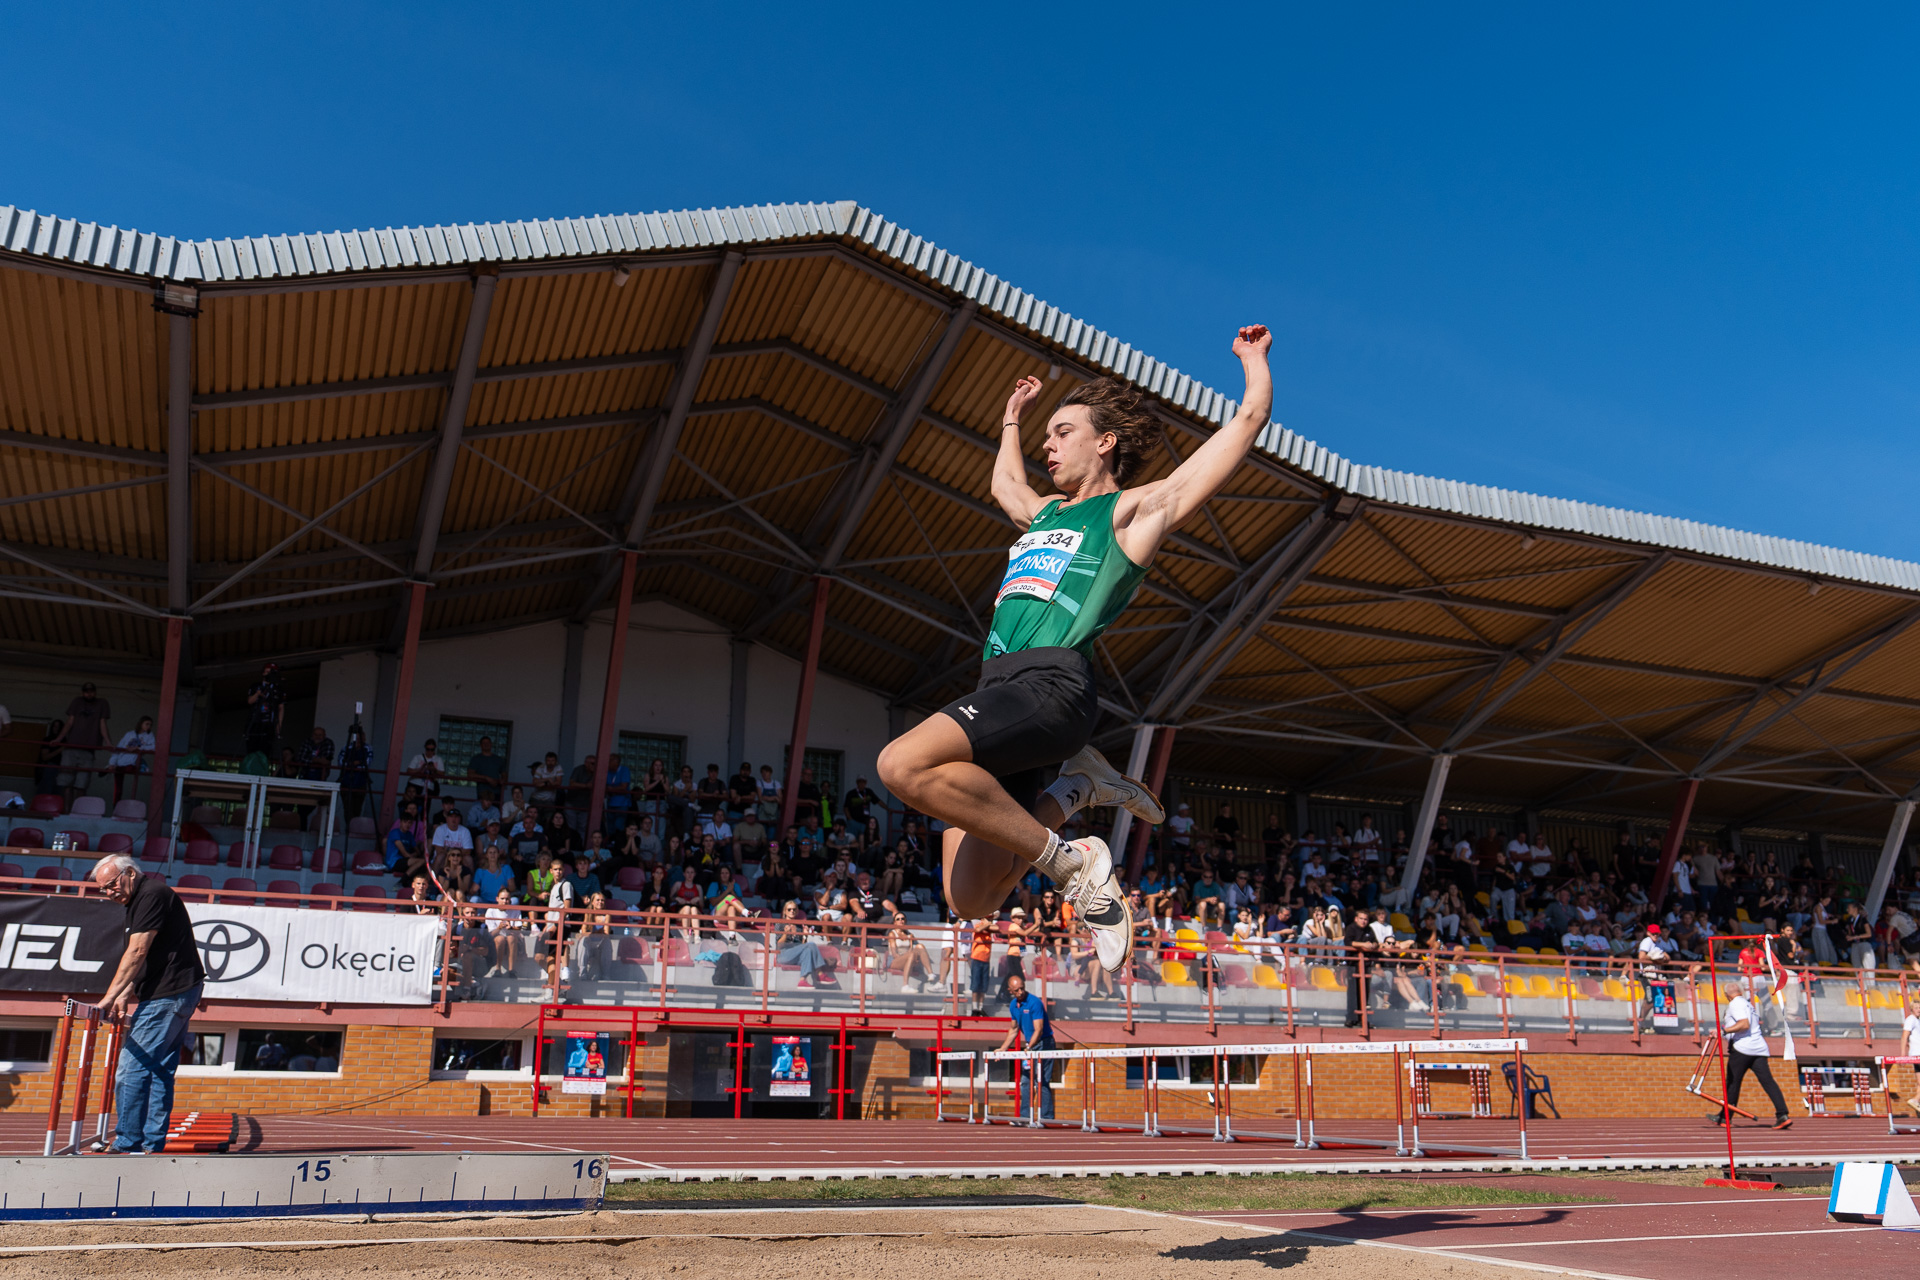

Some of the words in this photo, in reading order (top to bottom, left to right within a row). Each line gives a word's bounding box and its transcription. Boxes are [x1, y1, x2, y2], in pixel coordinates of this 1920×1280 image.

[1042, 532, 1075, 548] 334
[1080, 879, 1097, 910] NIKE
[300, 943, 416, 978] Okęcie
[296, 1159, 332, 1183] 15
[572, 1158, 603, 1180] 16
